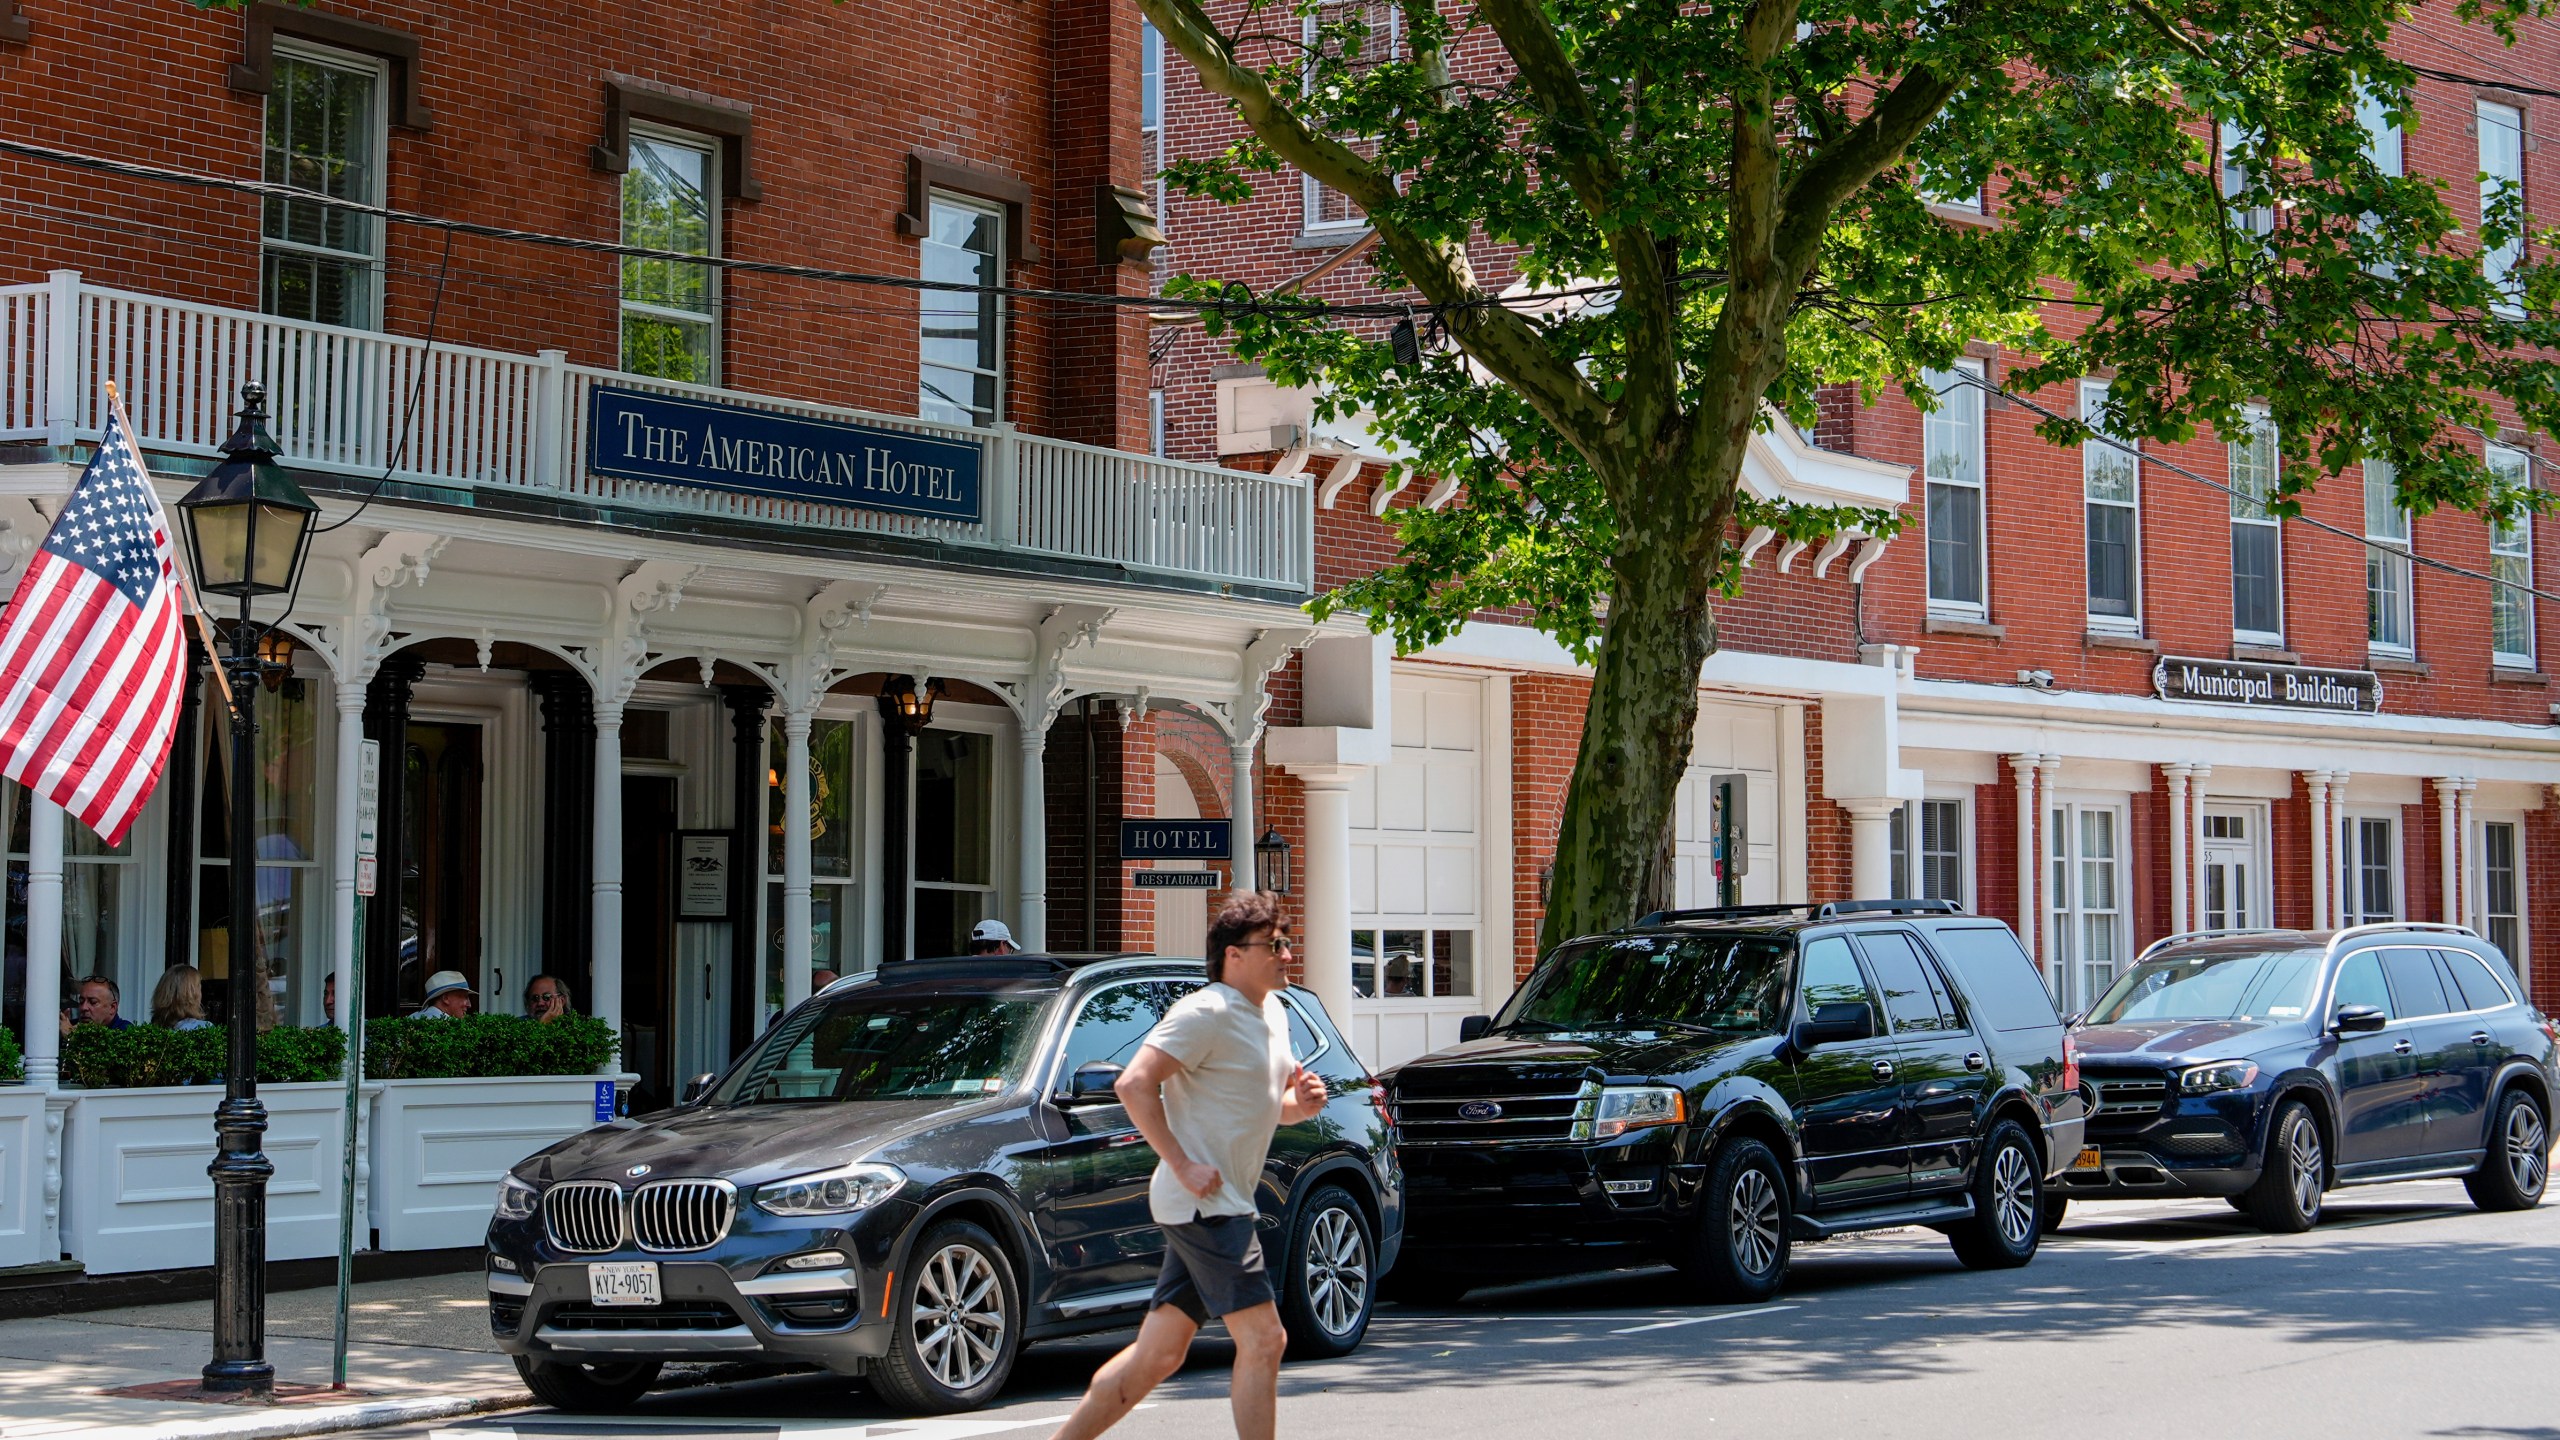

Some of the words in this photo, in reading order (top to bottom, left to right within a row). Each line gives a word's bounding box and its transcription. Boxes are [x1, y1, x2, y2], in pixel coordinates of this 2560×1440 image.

[2182, 665, 2273, 703] Municipal
[2285, 673, 2358, 711] Building
[1133, 830, 1218, 849] HOTEL
[1140, 874, 1215, 885] RESTAURANT
[1465, 1104, 1490, 1115] Ford
[606, 1266, 621, 1274] NEW
